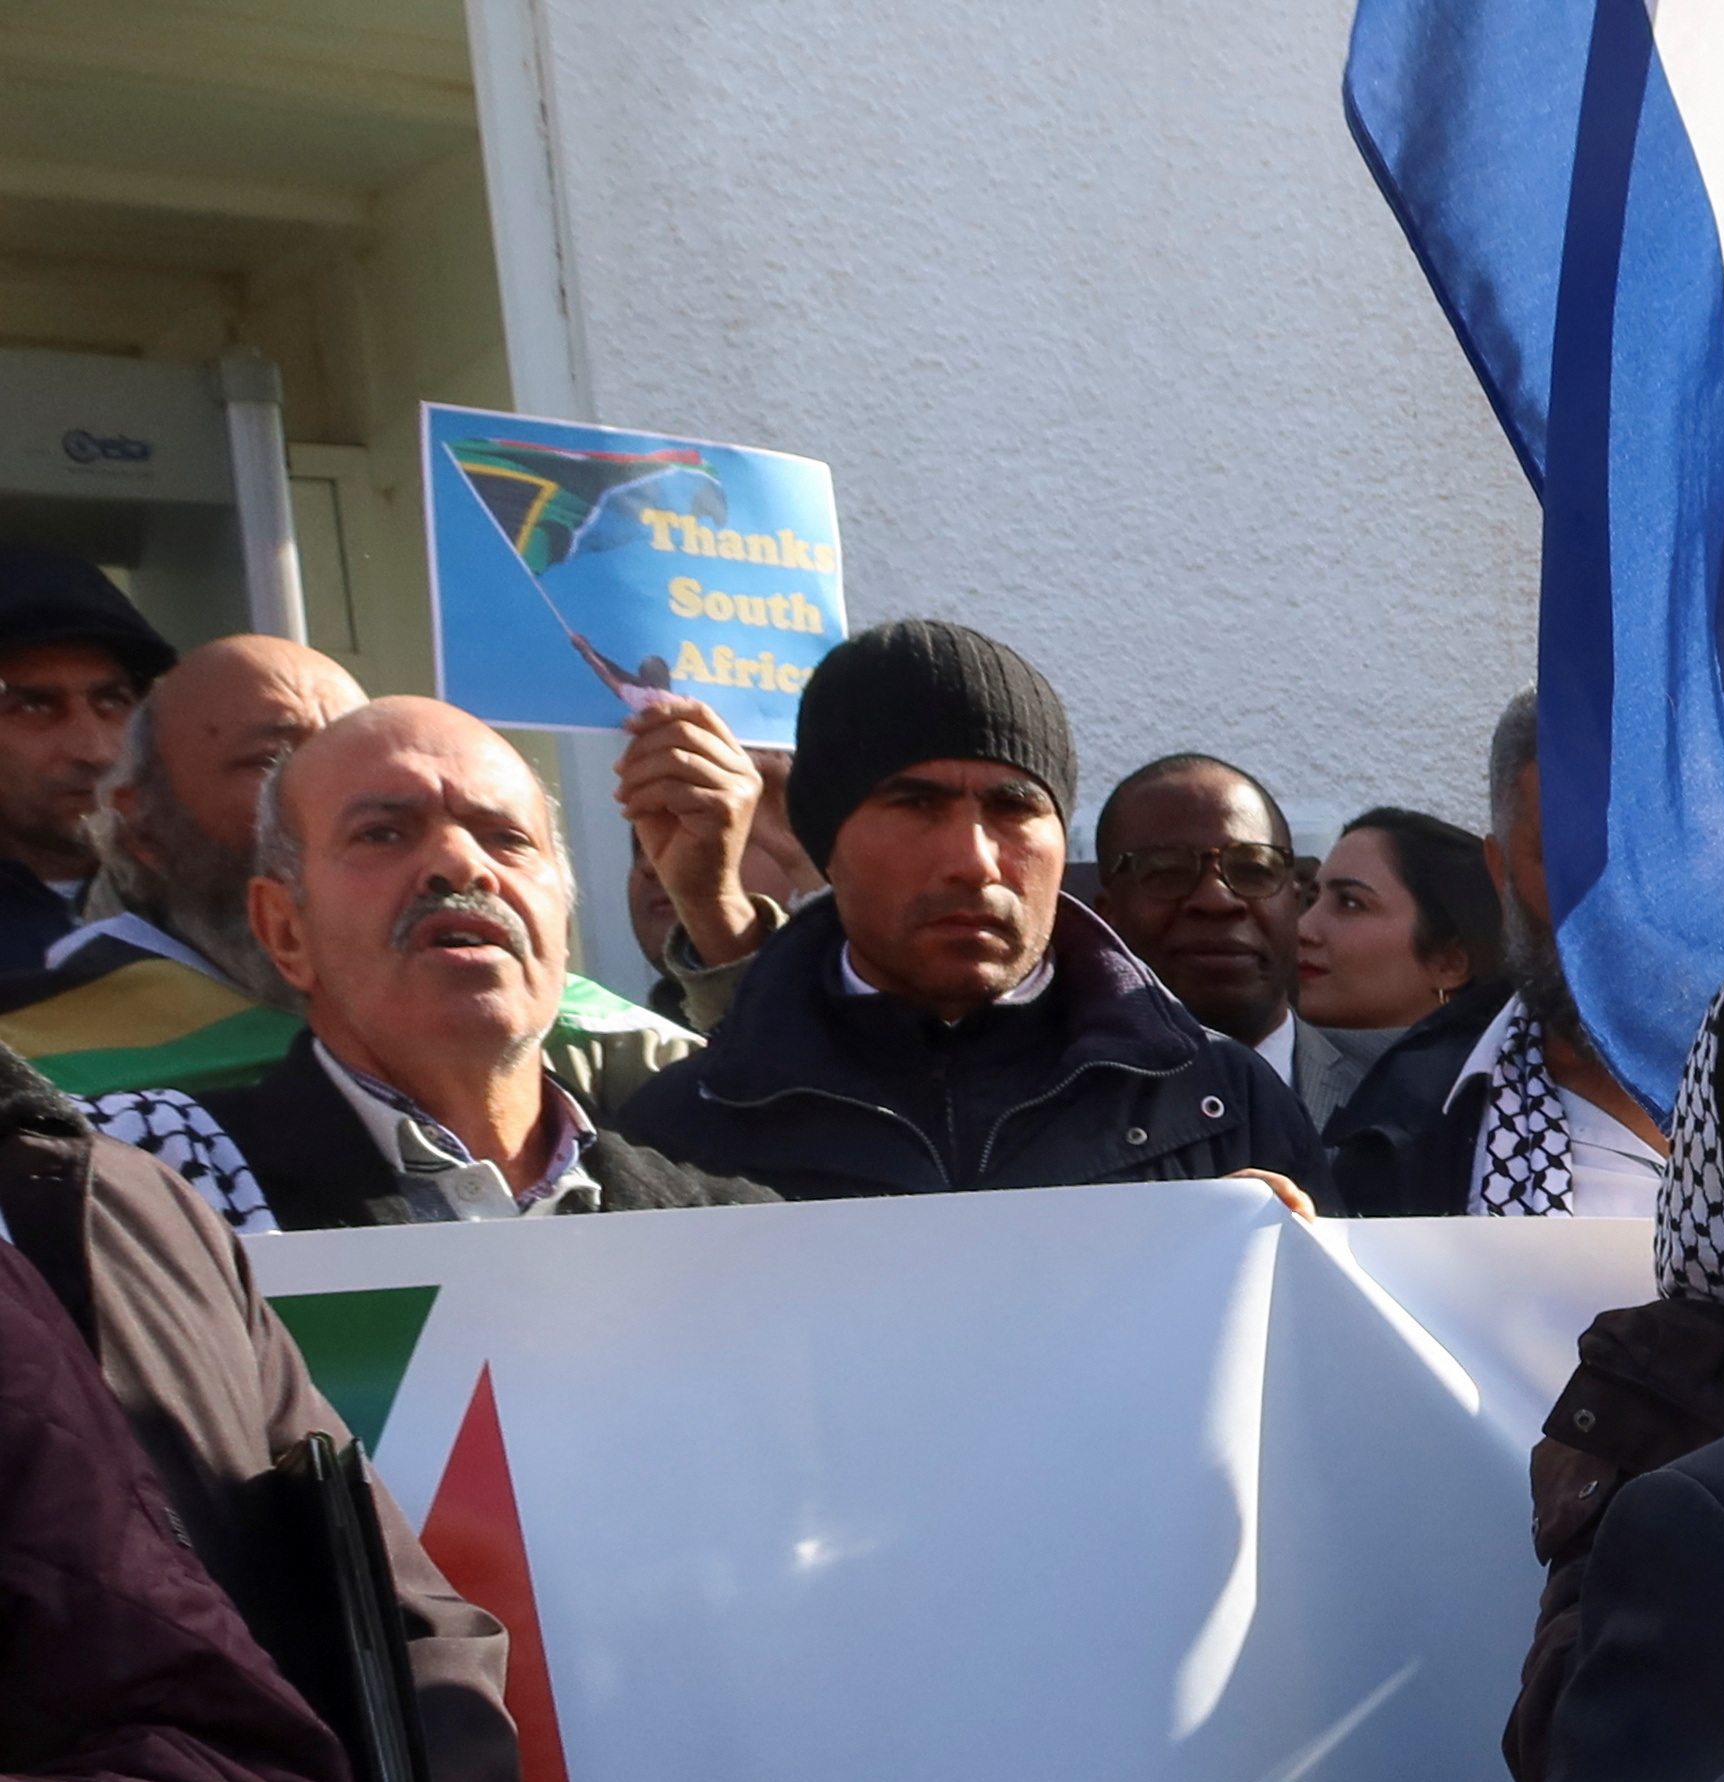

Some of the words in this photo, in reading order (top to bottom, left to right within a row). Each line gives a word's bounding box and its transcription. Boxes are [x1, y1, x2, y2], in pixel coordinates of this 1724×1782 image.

[639, 507, 836, 573] Thanks
[668, 575, 824, 634] South
[670, 639, 814, 693] Afric
